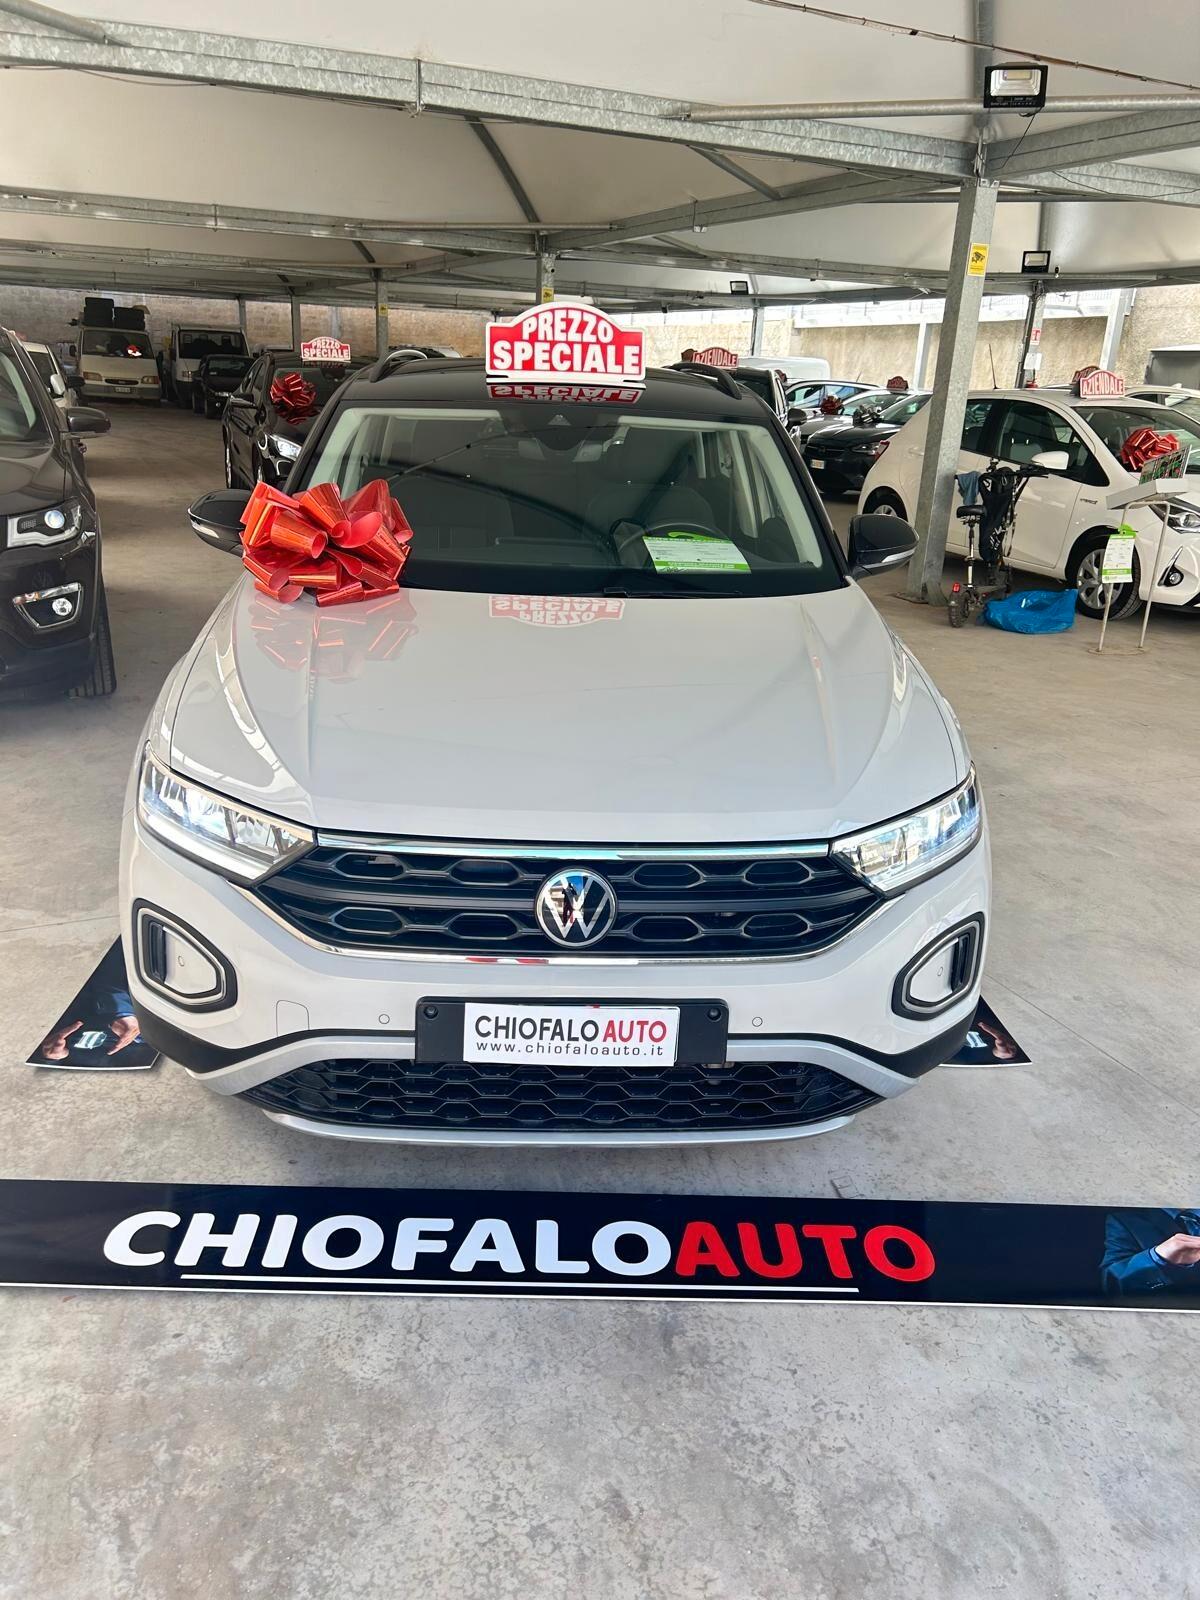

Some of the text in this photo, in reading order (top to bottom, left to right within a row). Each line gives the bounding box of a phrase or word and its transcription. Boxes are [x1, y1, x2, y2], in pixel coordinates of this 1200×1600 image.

[522, 308, 614, 344] PREZZO
[311, 339, 340, 349] PREZZO
[303, 348, 348, 358] SPECIALE
[493, 340, 640, 375] SPECIALE
[695, 349, 737, 366] AZIENDALE
[1082, 372, 1123, 395] AZIENDALE
[476, 1040, 664, 1057] www.chiofaloauto.it
